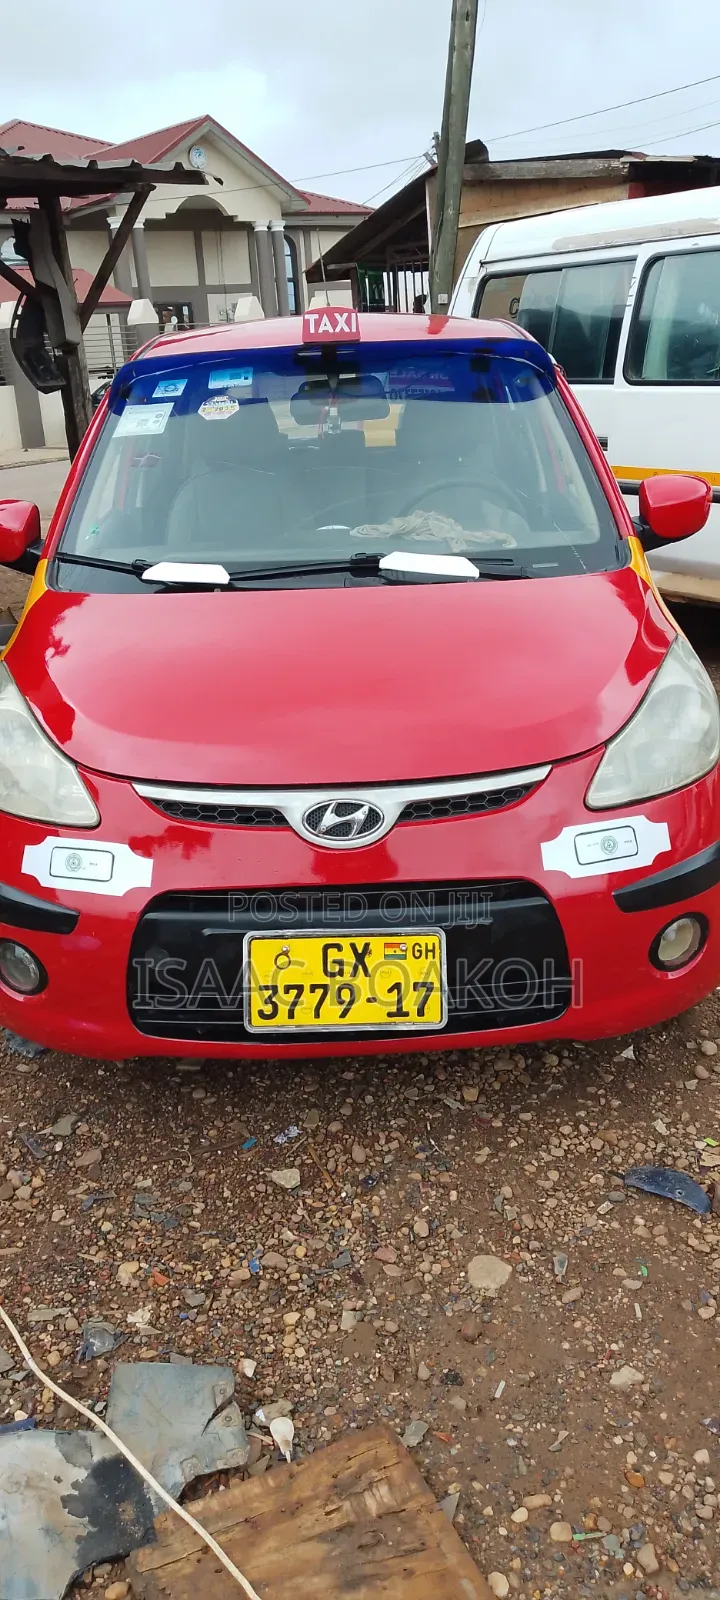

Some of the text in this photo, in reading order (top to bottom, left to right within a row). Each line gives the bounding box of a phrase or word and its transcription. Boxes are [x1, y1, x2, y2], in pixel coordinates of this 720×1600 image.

[304, 312, 357, 333] TAXI
[321, 942, 371, 978] GX
[411, 942, 436, 960] GH
